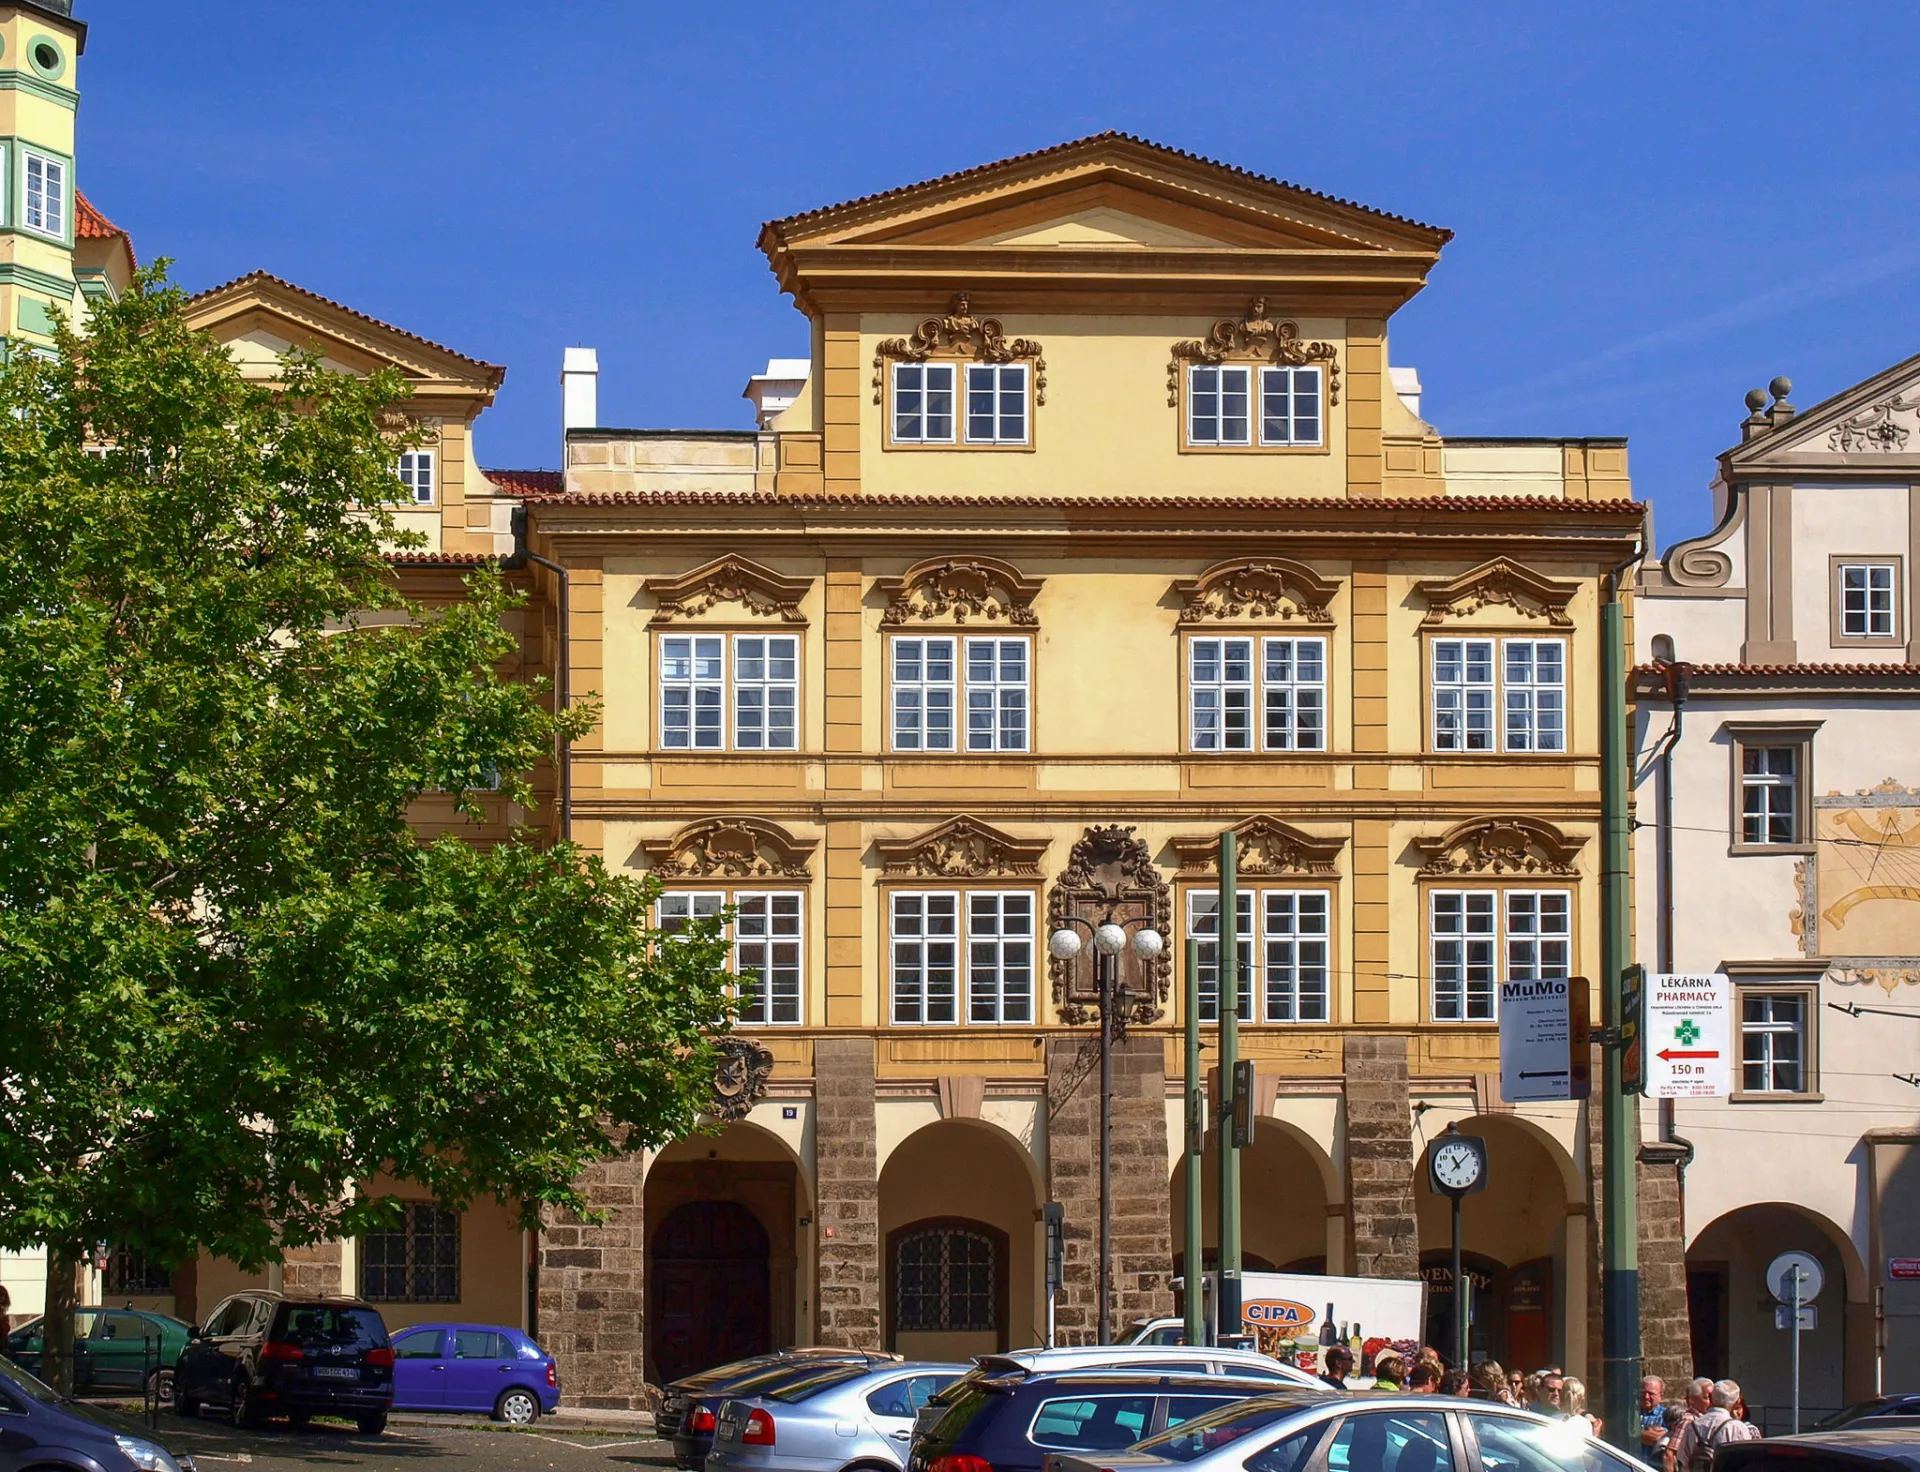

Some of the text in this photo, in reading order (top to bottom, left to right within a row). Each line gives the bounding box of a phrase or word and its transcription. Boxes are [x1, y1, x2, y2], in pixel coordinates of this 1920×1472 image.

[1503, 981, 1566, 997] MuMo
[1661, 976, 1711, 988] LÉKÁRNA
[1657, 992, 1716, 1001] PHARMACY
[1671, 1064, 1705, 1074] 150 m
[1420, 1267, 1491, 1289] VENRY
[1247, 1305, 1298, 1321] CIPA
